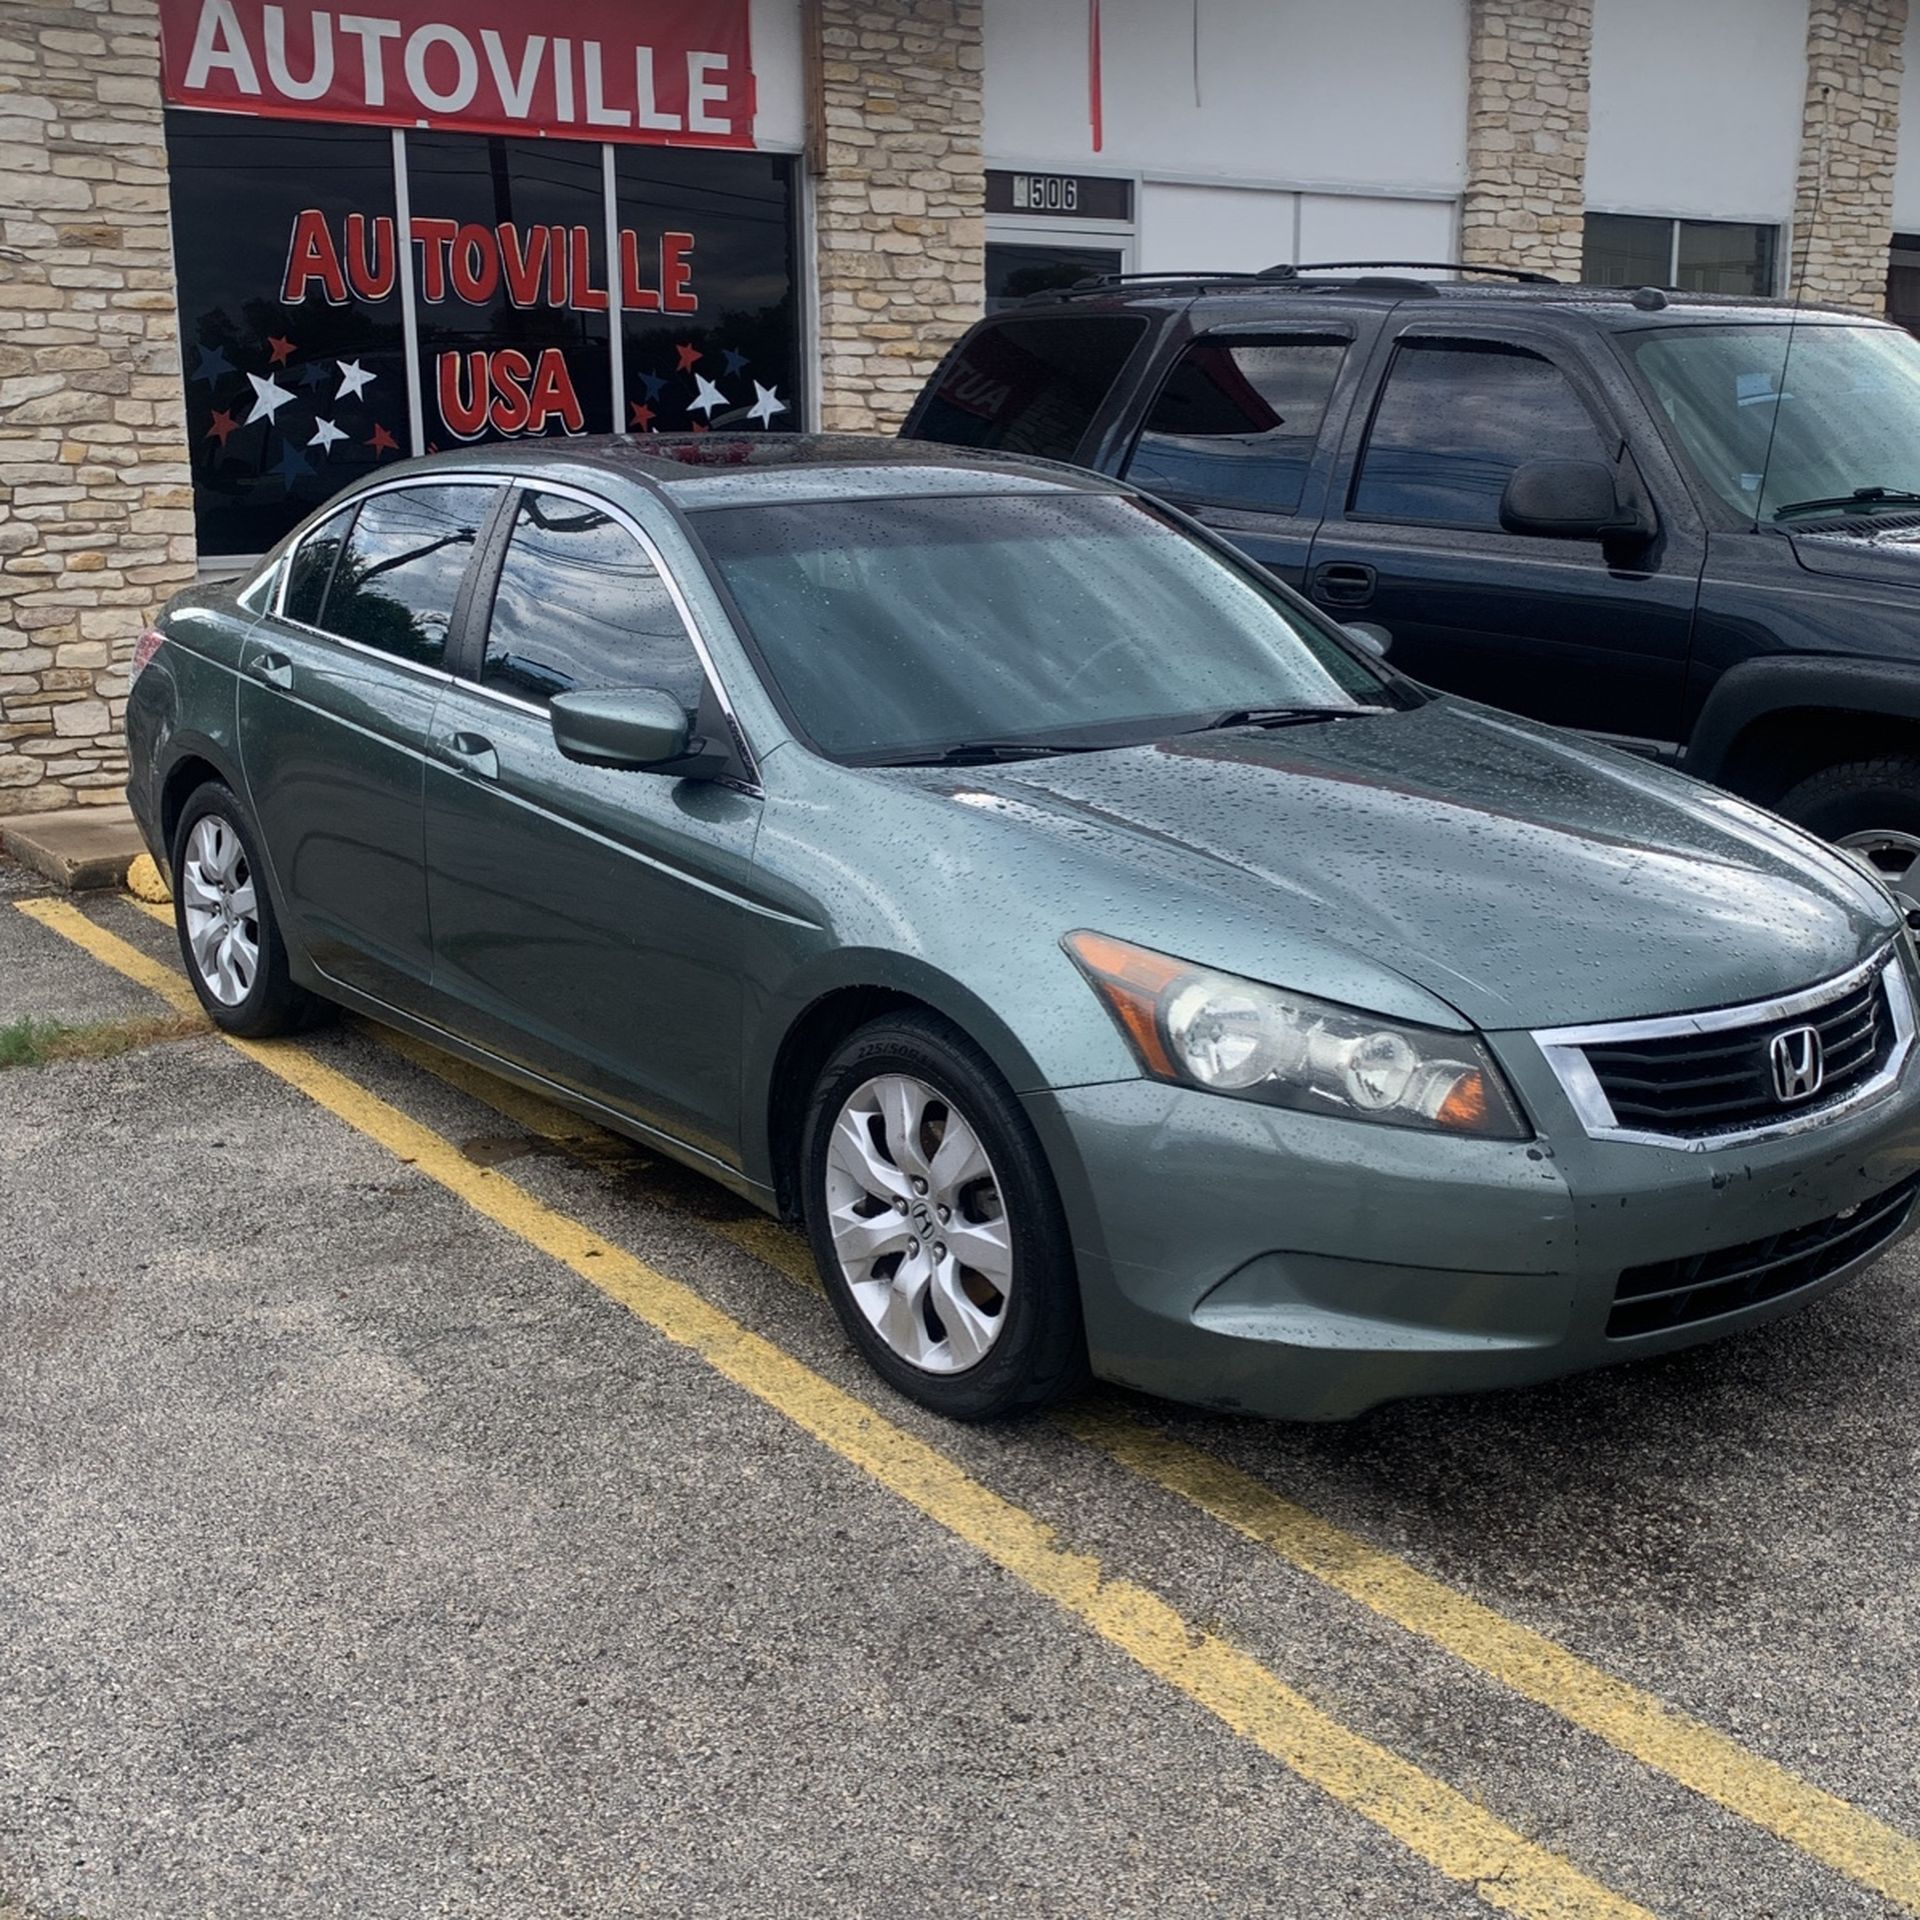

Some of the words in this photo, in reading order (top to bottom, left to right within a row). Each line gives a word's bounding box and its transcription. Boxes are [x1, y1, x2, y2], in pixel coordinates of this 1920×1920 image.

[184, 0, 732, 135] AUTOVILLE
[280, 208, 698, 316] AUTOVILLE
[435, 347, 588, 440] USA
